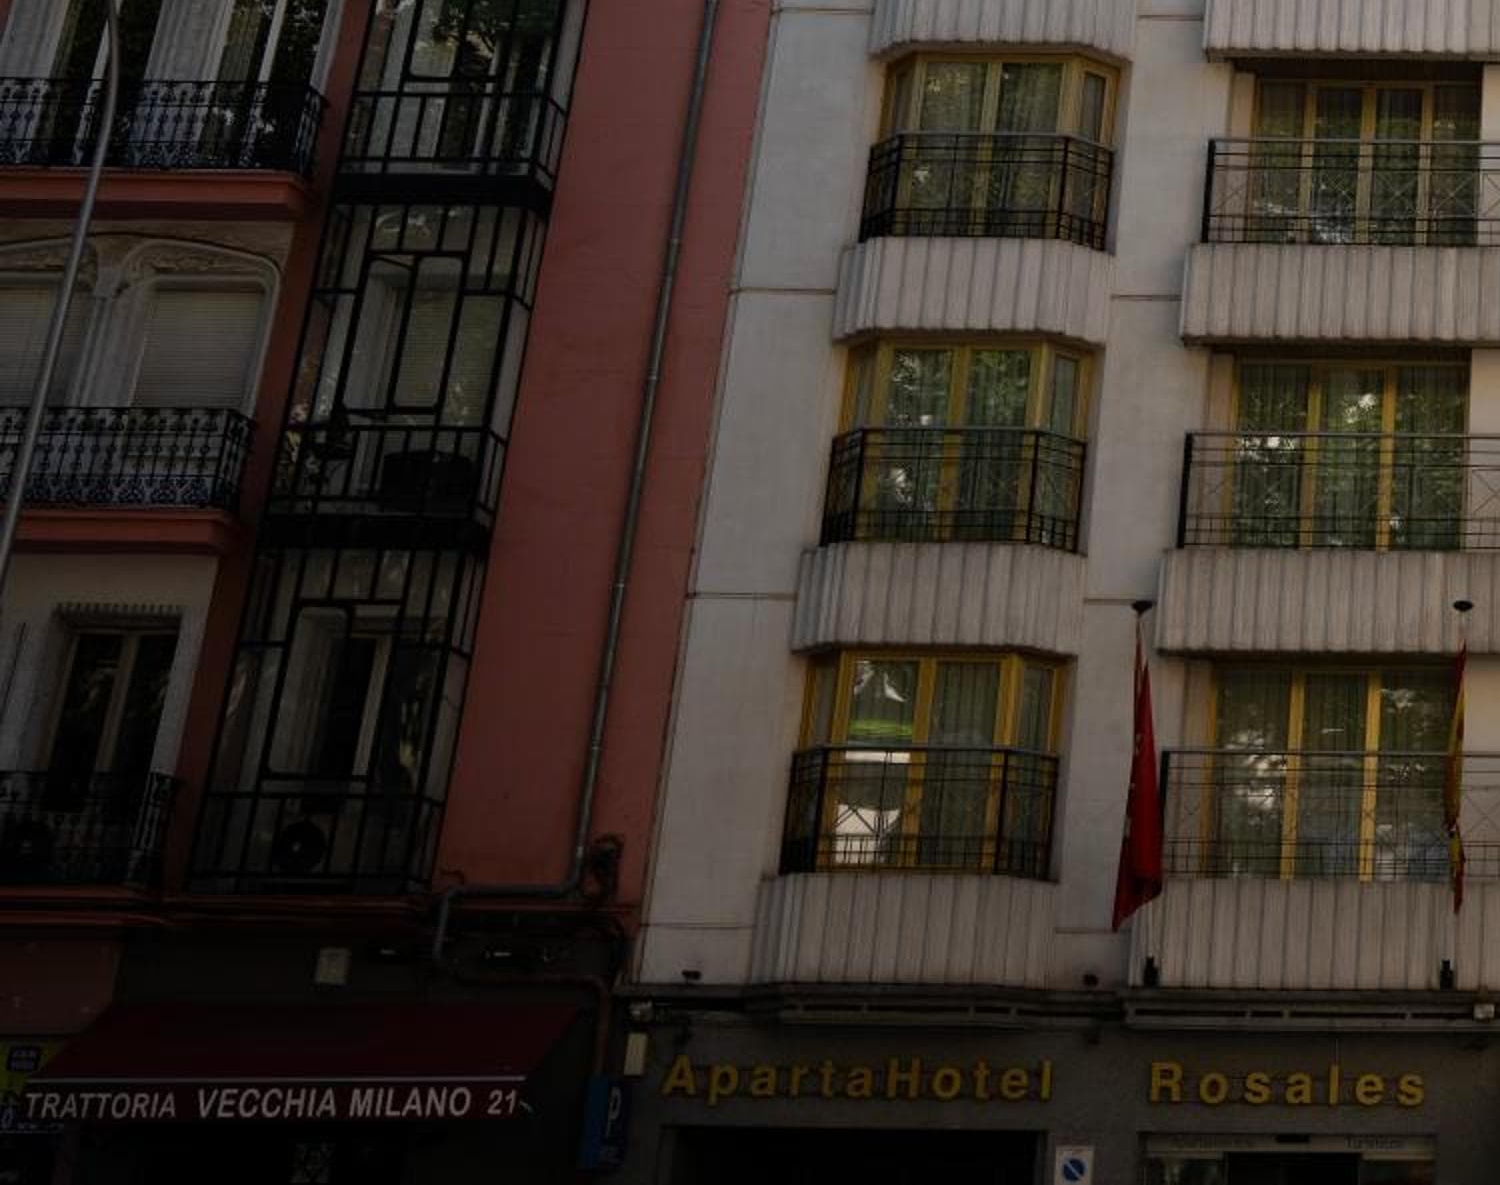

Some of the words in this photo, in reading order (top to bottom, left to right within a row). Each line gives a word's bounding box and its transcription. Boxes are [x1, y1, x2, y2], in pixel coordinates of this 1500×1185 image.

[660, 1053, 1053, 1106] ApartaHotel
[1148, 1059, 1426, 1107] Rosales
[25, 1091, 176, 1119] TRATTORIA
[198, 1086, 337, 1118] VECCHIA
[348, 1086, 473, 1118] MILANO
